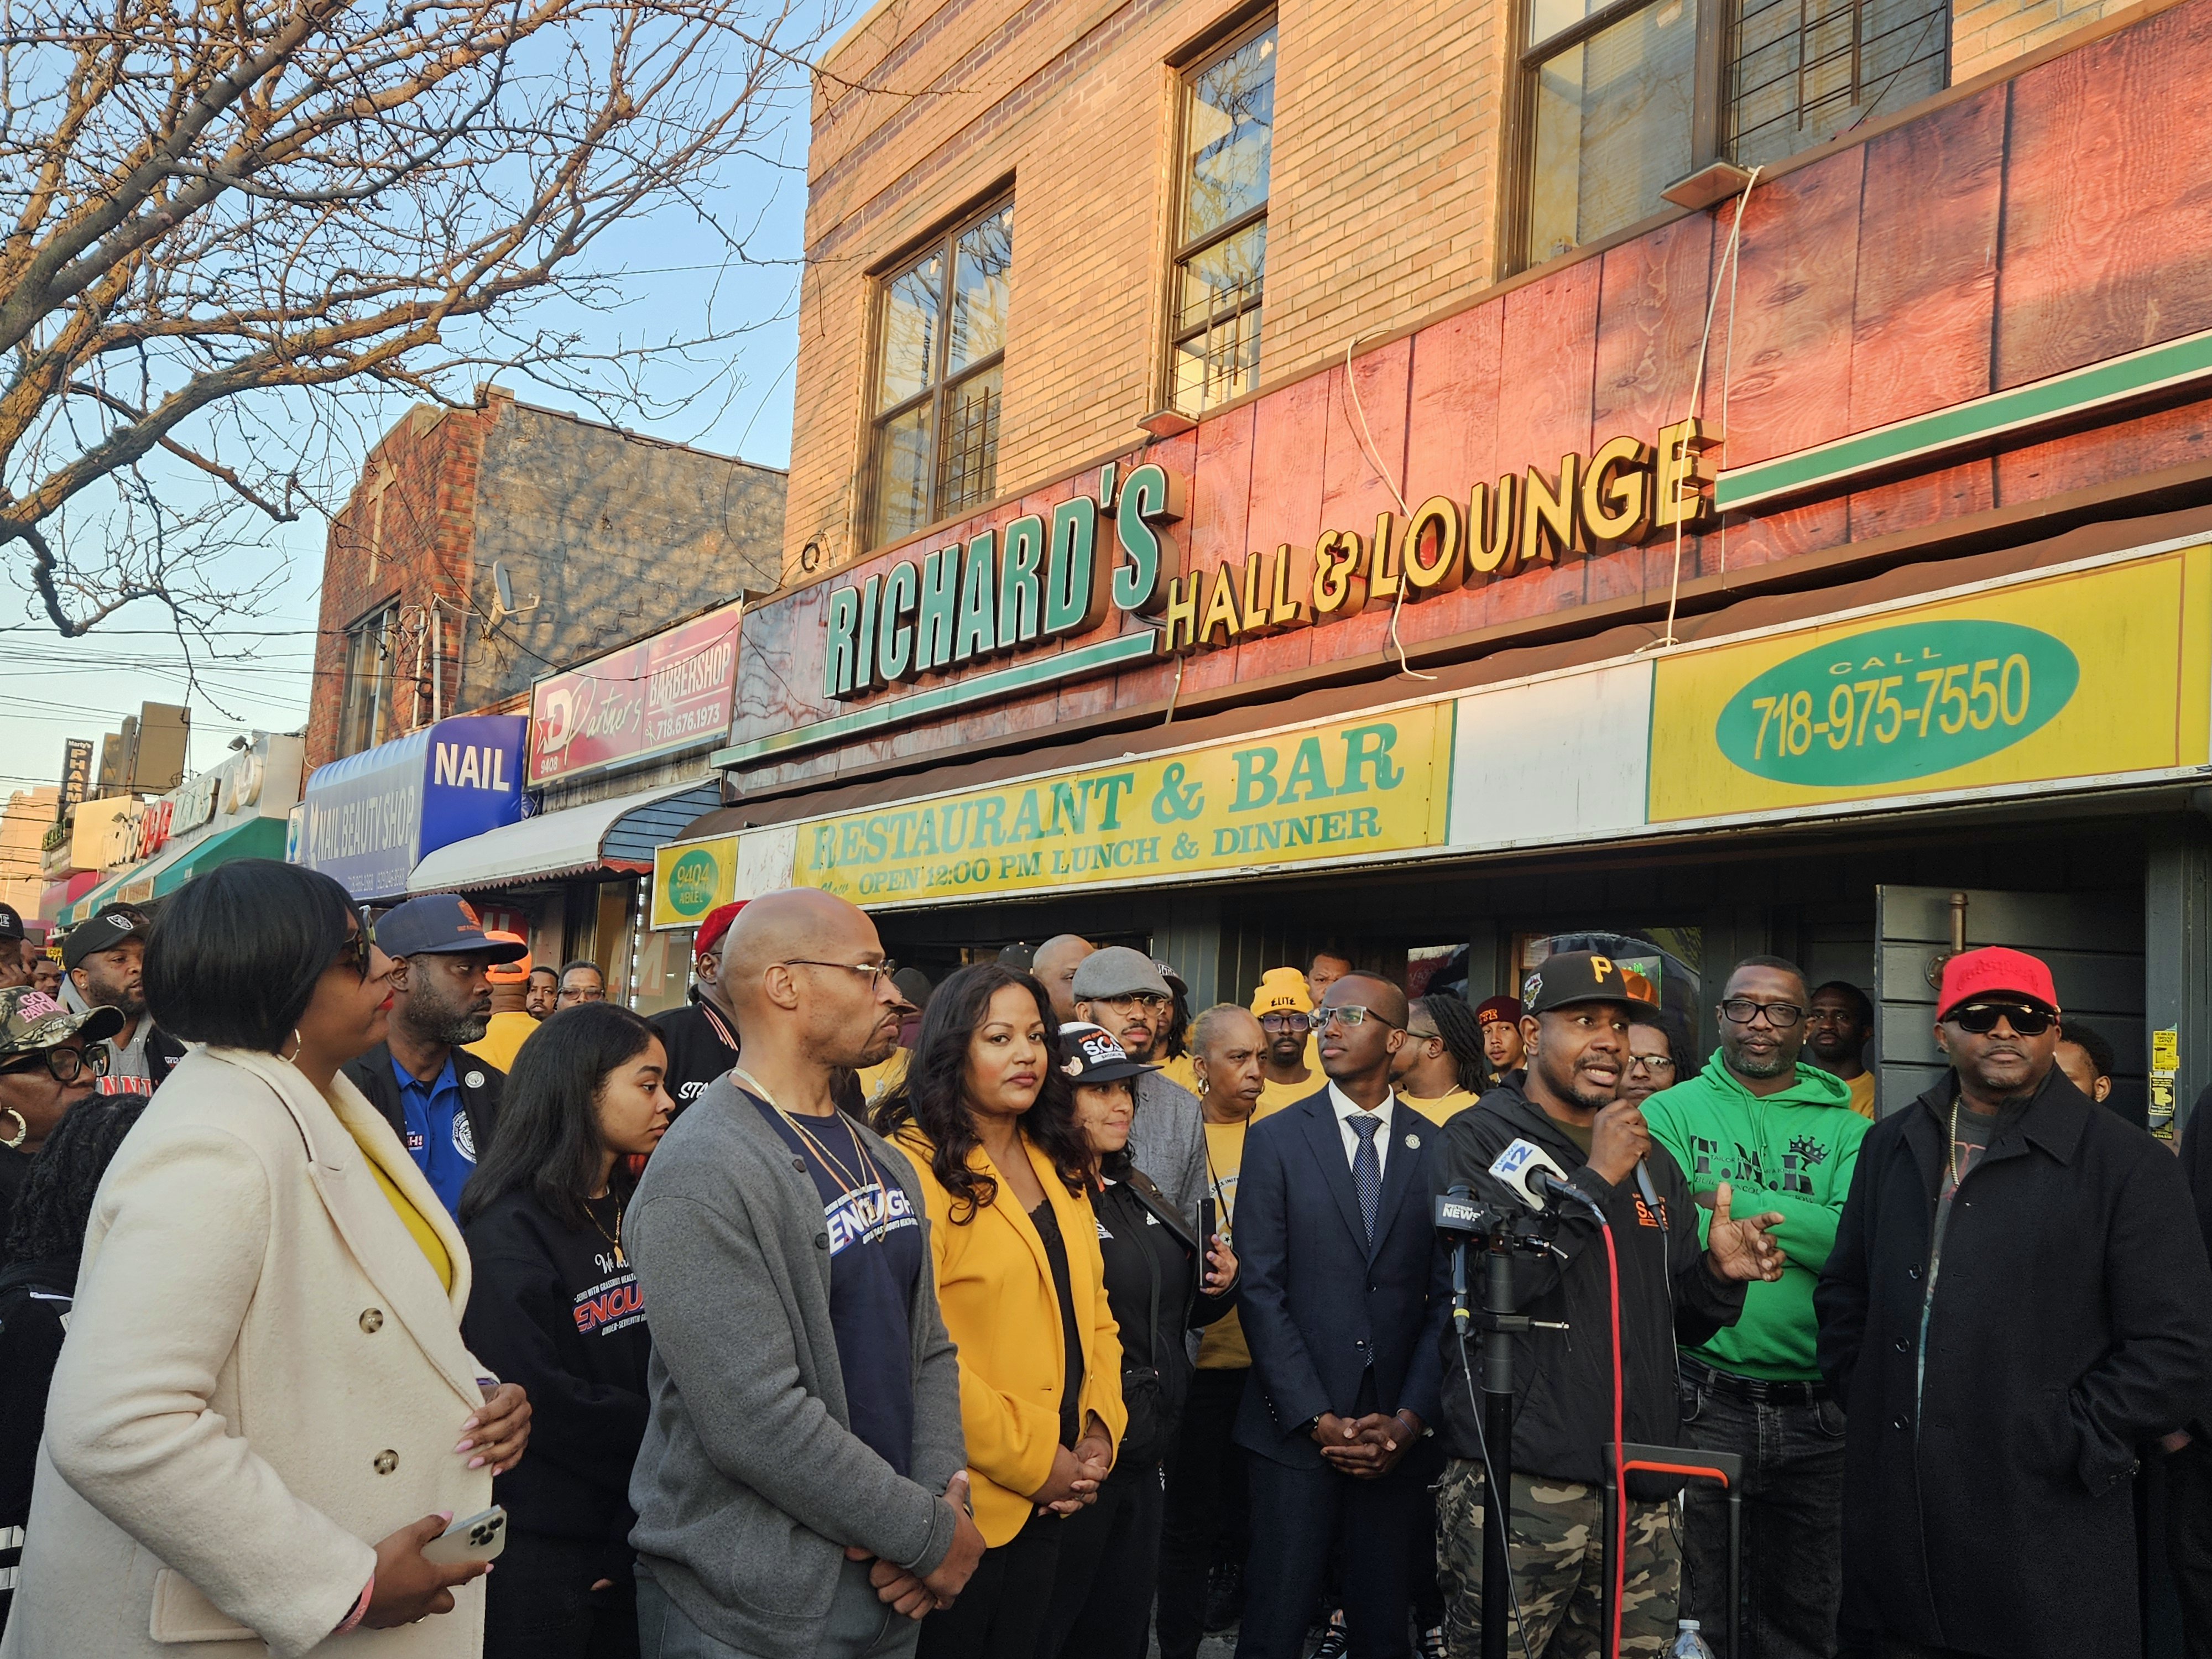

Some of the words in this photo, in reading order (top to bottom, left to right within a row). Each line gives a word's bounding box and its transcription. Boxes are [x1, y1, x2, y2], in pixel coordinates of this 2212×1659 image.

[1165, 542, 1303, 653] HALL
[1313, 529, 1360, 613] &
[1371, 417, 1702, 599] LOUNGE
[823, 461, 1168, 699] RICHARD'S
[649, 642, 731, 707] BARBERSHOP
[1829, 646, 1942, 675] CALL
[656, 702, 721, 741] 718.676.1973
[1752, 653, 2031, 760] 718-975-7550
[64, 748, 87, 813] PHARM
[434, 742, 510, 792] NAIL
[540, 755, 558, 774] 9408
[809, 773, 1134, 870] RESTAURANT
[1151, 762, 1205, 824] &
[1228, 723, 1405, 813] BAR
[317, 806, 339, 862] NAIL
[341, 795, 383, 858] BEAUTY
[382, 785, 415, 852] SHOP
[676, 862, 710, 889] 9404
[858, 867, 926, 895] OPEN
[927, 858, 990, 887] 12:00
[998, 851, 1043, 879] PM
[1051, 836, 1161, 874] LUNCH
[1171, 832, 1199, 860] &
[1211, 806, 1383, 857] DINNER
[1590, 956, 1613, 983] P
[1271, 997, 1296, 1006] ELITE
[1494, 1142, 1520, 1170] news
[1501, 1146, 1533, 1173] 12
